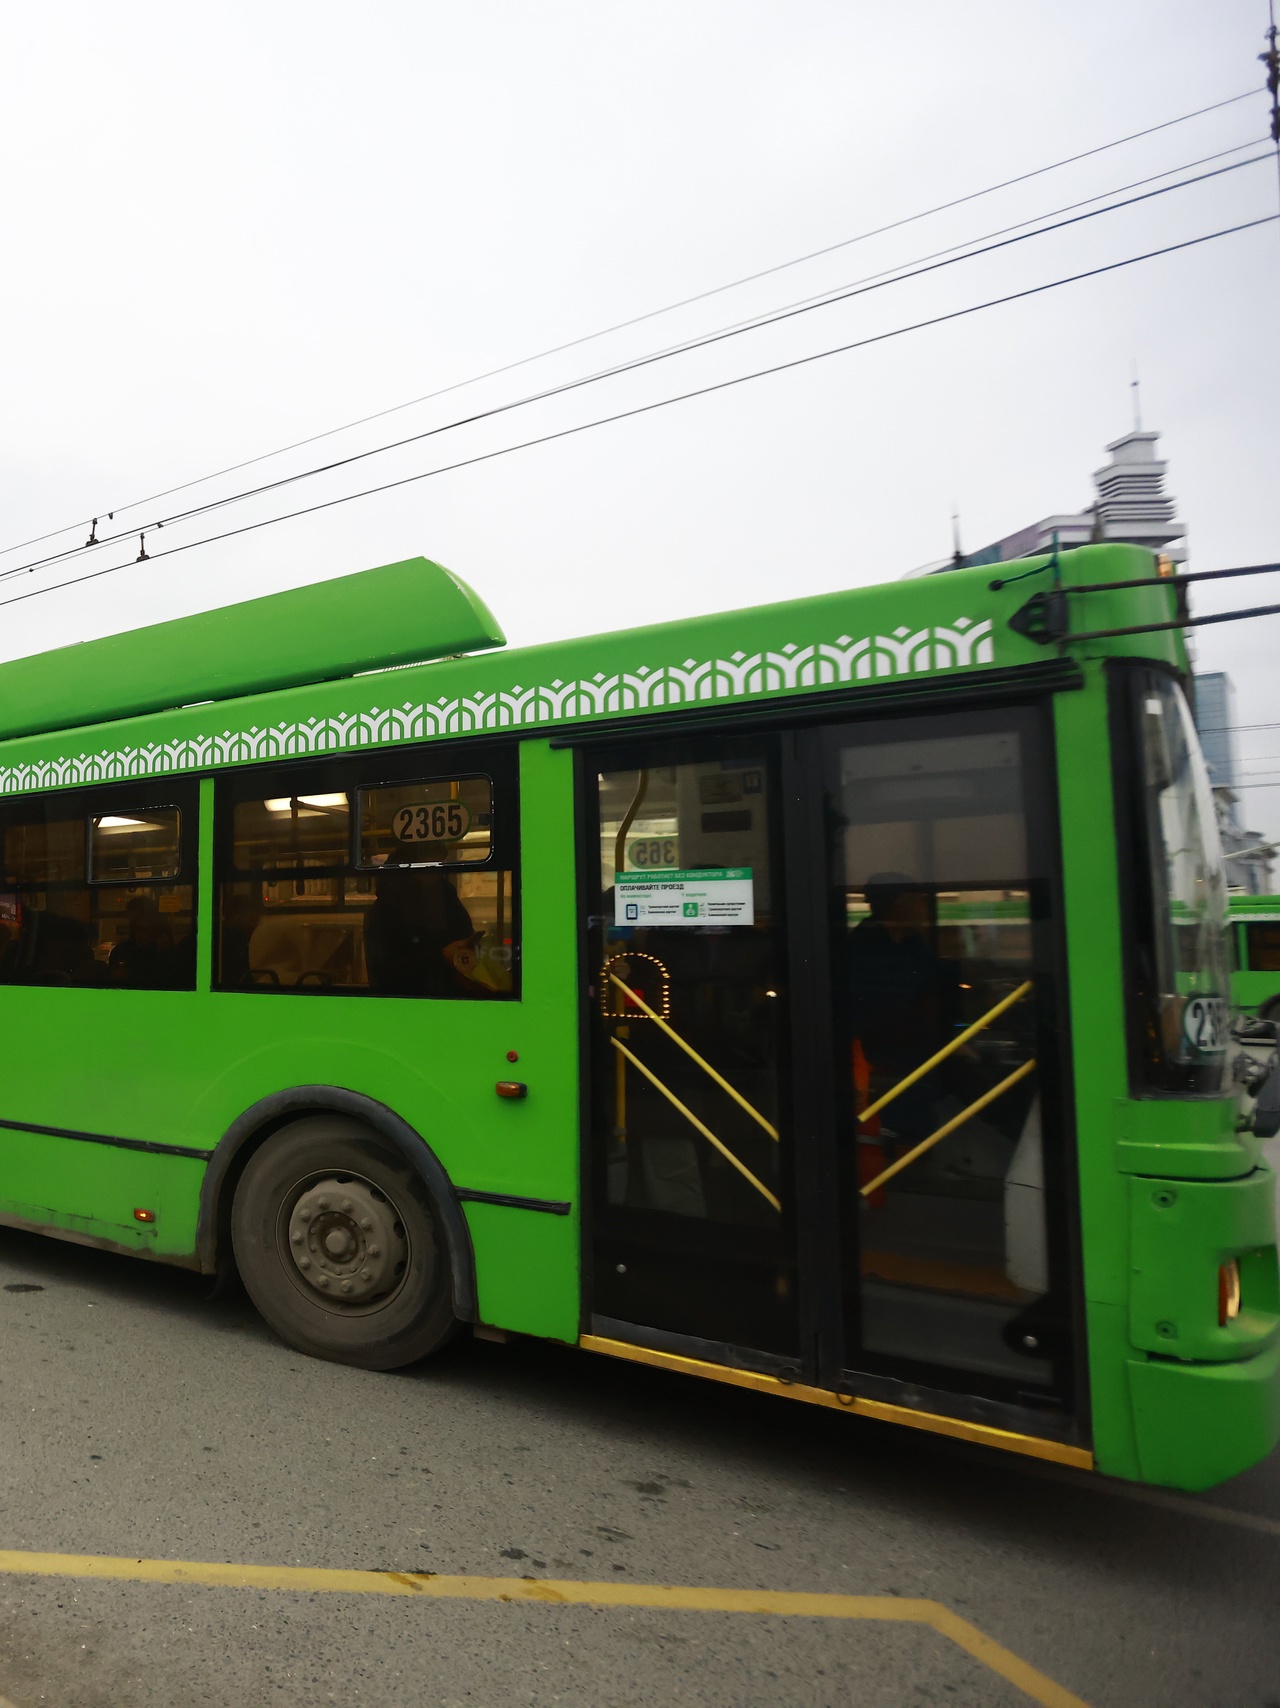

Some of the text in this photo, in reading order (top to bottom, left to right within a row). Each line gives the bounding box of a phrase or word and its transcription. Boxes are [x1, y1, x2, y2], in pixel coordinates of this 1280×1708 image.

[399, 805, 463, 839] 2365
[619, 883, 685, 892] ОПЛАЧИВАЙТЕ ПРОЕЗД
